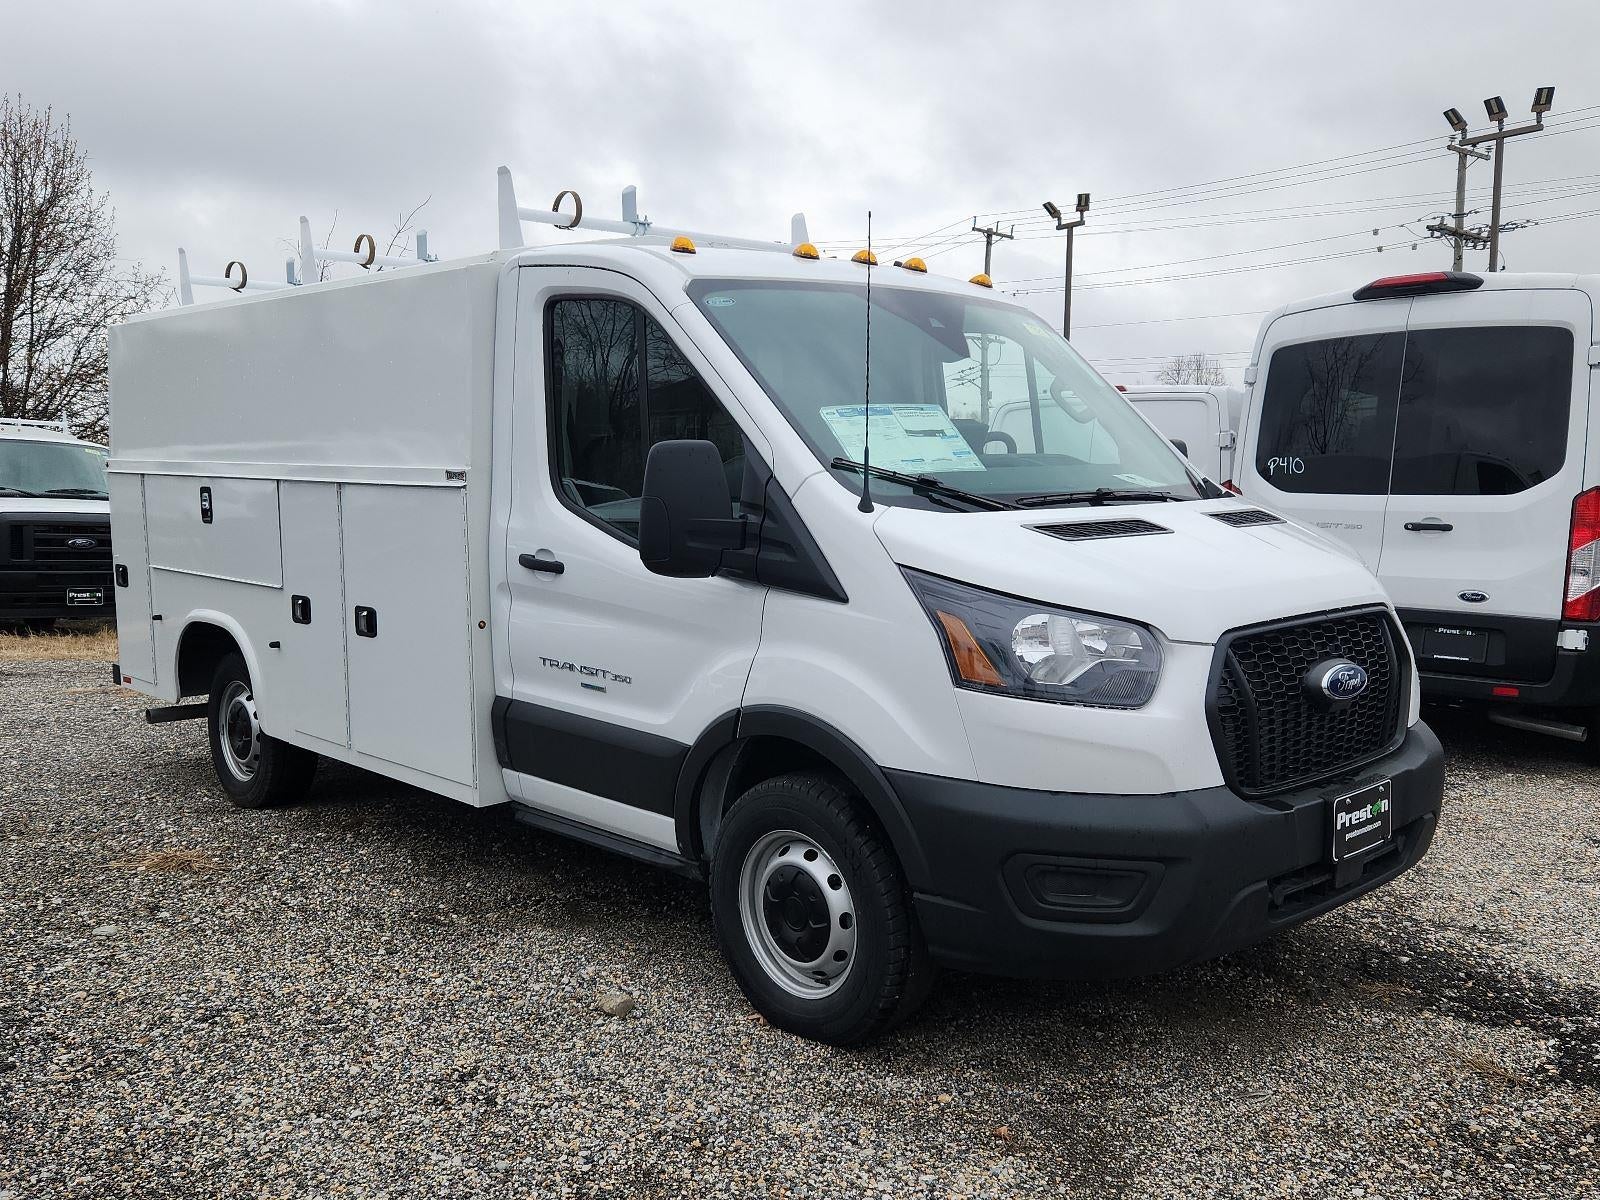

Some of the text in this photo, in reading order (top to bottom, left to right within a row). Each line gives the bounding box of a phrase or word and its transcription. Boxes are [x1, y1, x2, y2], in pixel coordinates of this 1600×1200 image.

[1267, 456, 1305, 476] P410
[538, 656, 633, 684] TRANSIT 350
[1337, 669, 1361, 691] Ford
